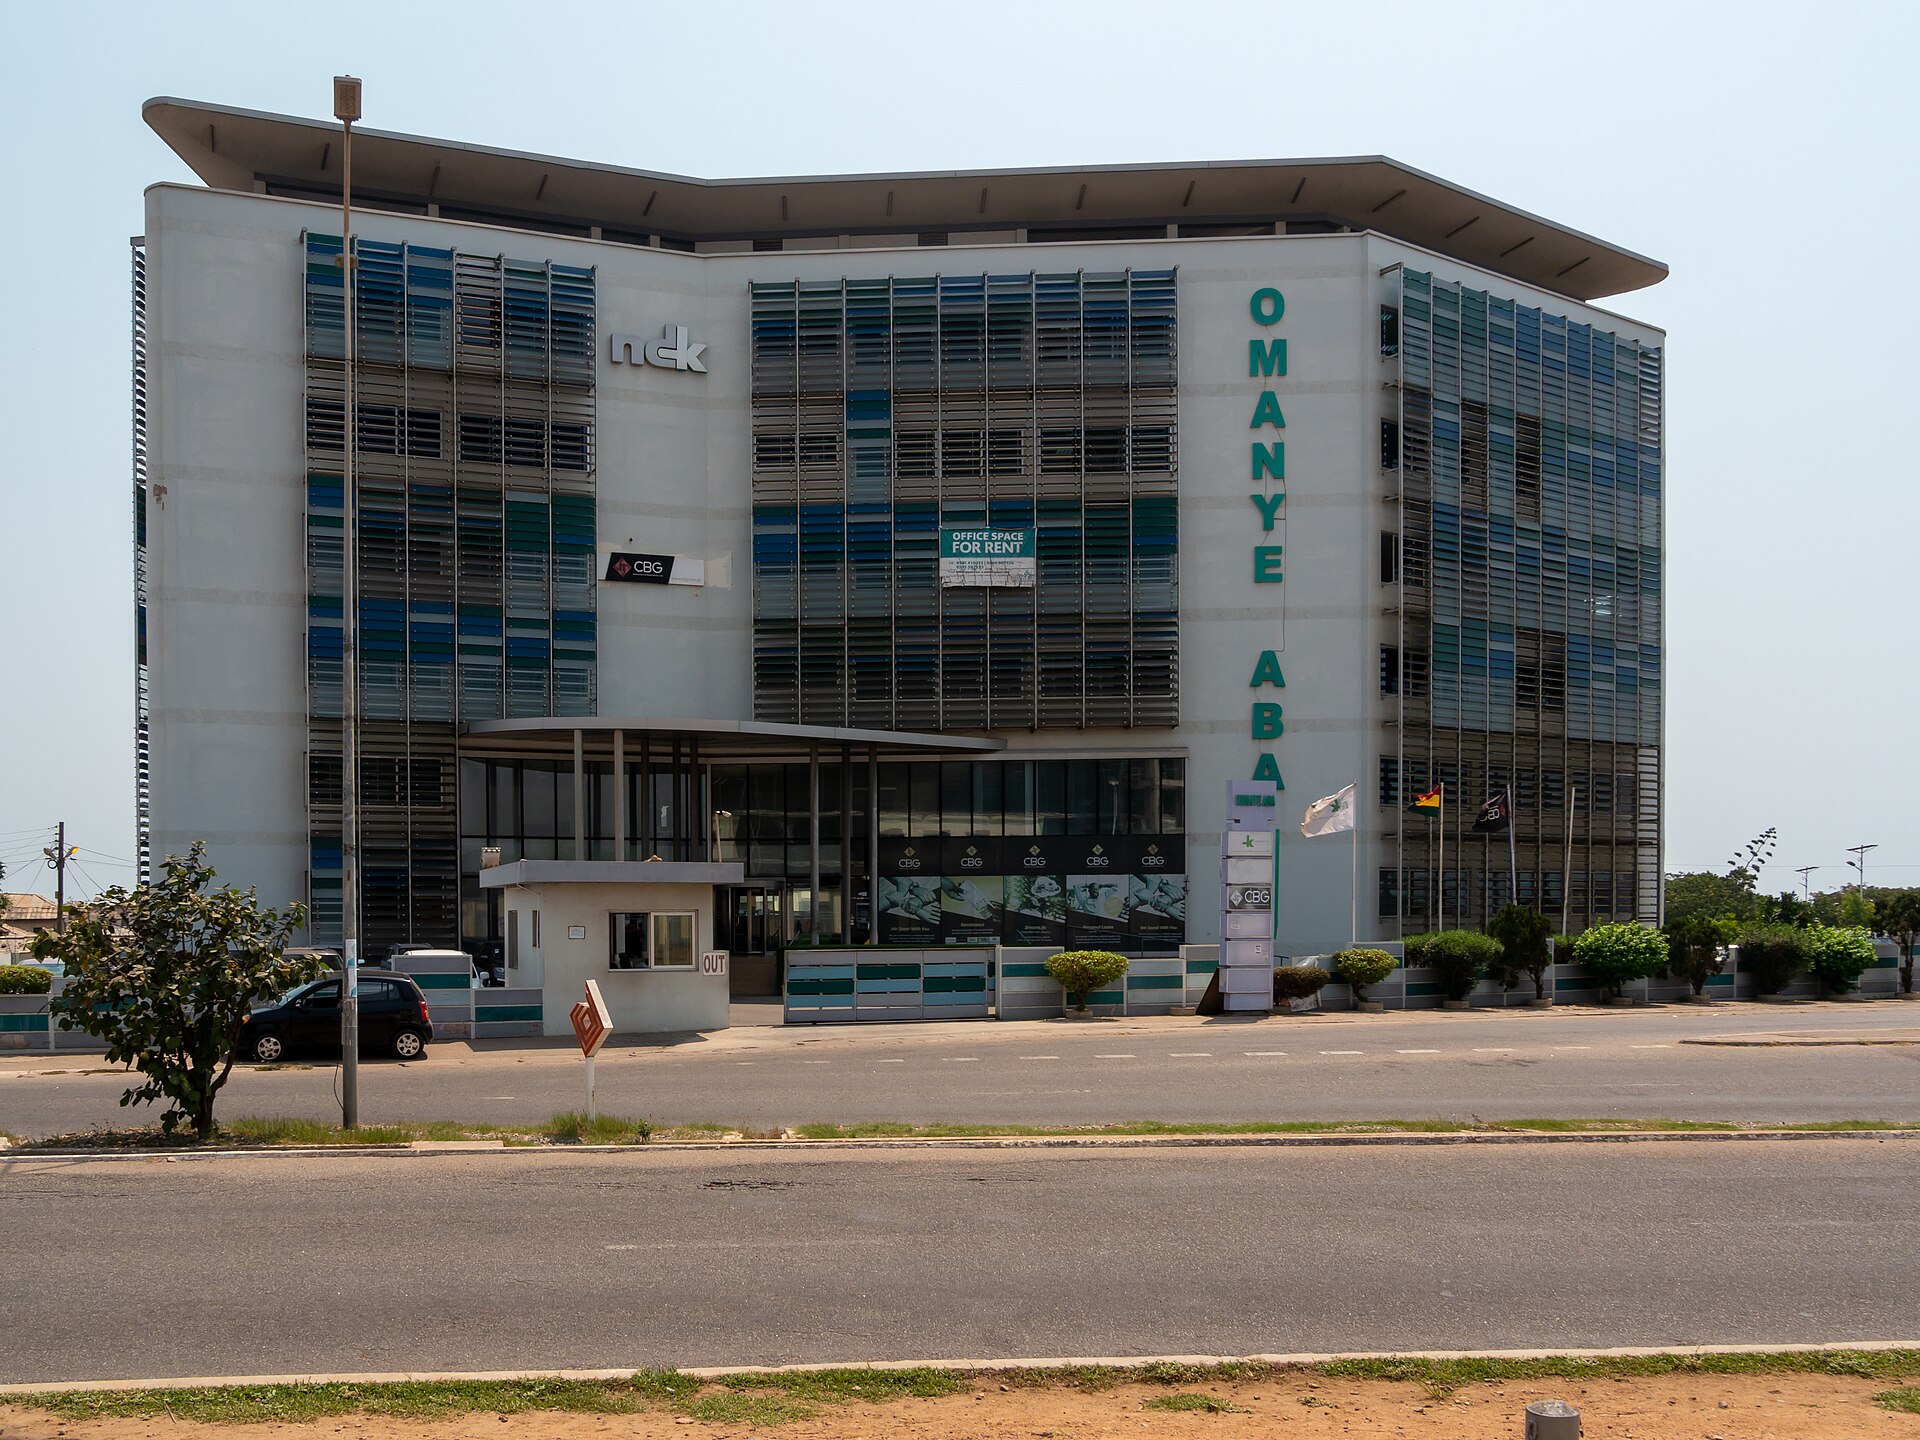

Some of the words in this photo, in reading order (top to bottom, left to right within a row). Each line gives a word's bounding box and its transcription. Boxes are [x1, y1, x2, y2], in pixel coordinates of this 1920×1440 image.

[610, 323, 708, 374] ndk
[1249, 287, 1287, 584] OMANYE
[952, 532, 989, 541] OFFICE
[991, 532, 1024, 541] SPACE
[952, 541, 981, 554] FOR
[984, 541, 1024, 554] RENT
[633, 561, 663, 574] CBG
[1249, 650, 1286, 791] ABA
[898, 858, 921, 868] CBG
[960, 857, 983, 867] CBG
[1023, 856, 1046, 867] CBG
[1086, 856, 1110, 866] CBG
[1141, 855, 1165, 866] CBG
[1244, 890, 1270, 903] CBG
[703, 954, 726, 973] OUT
